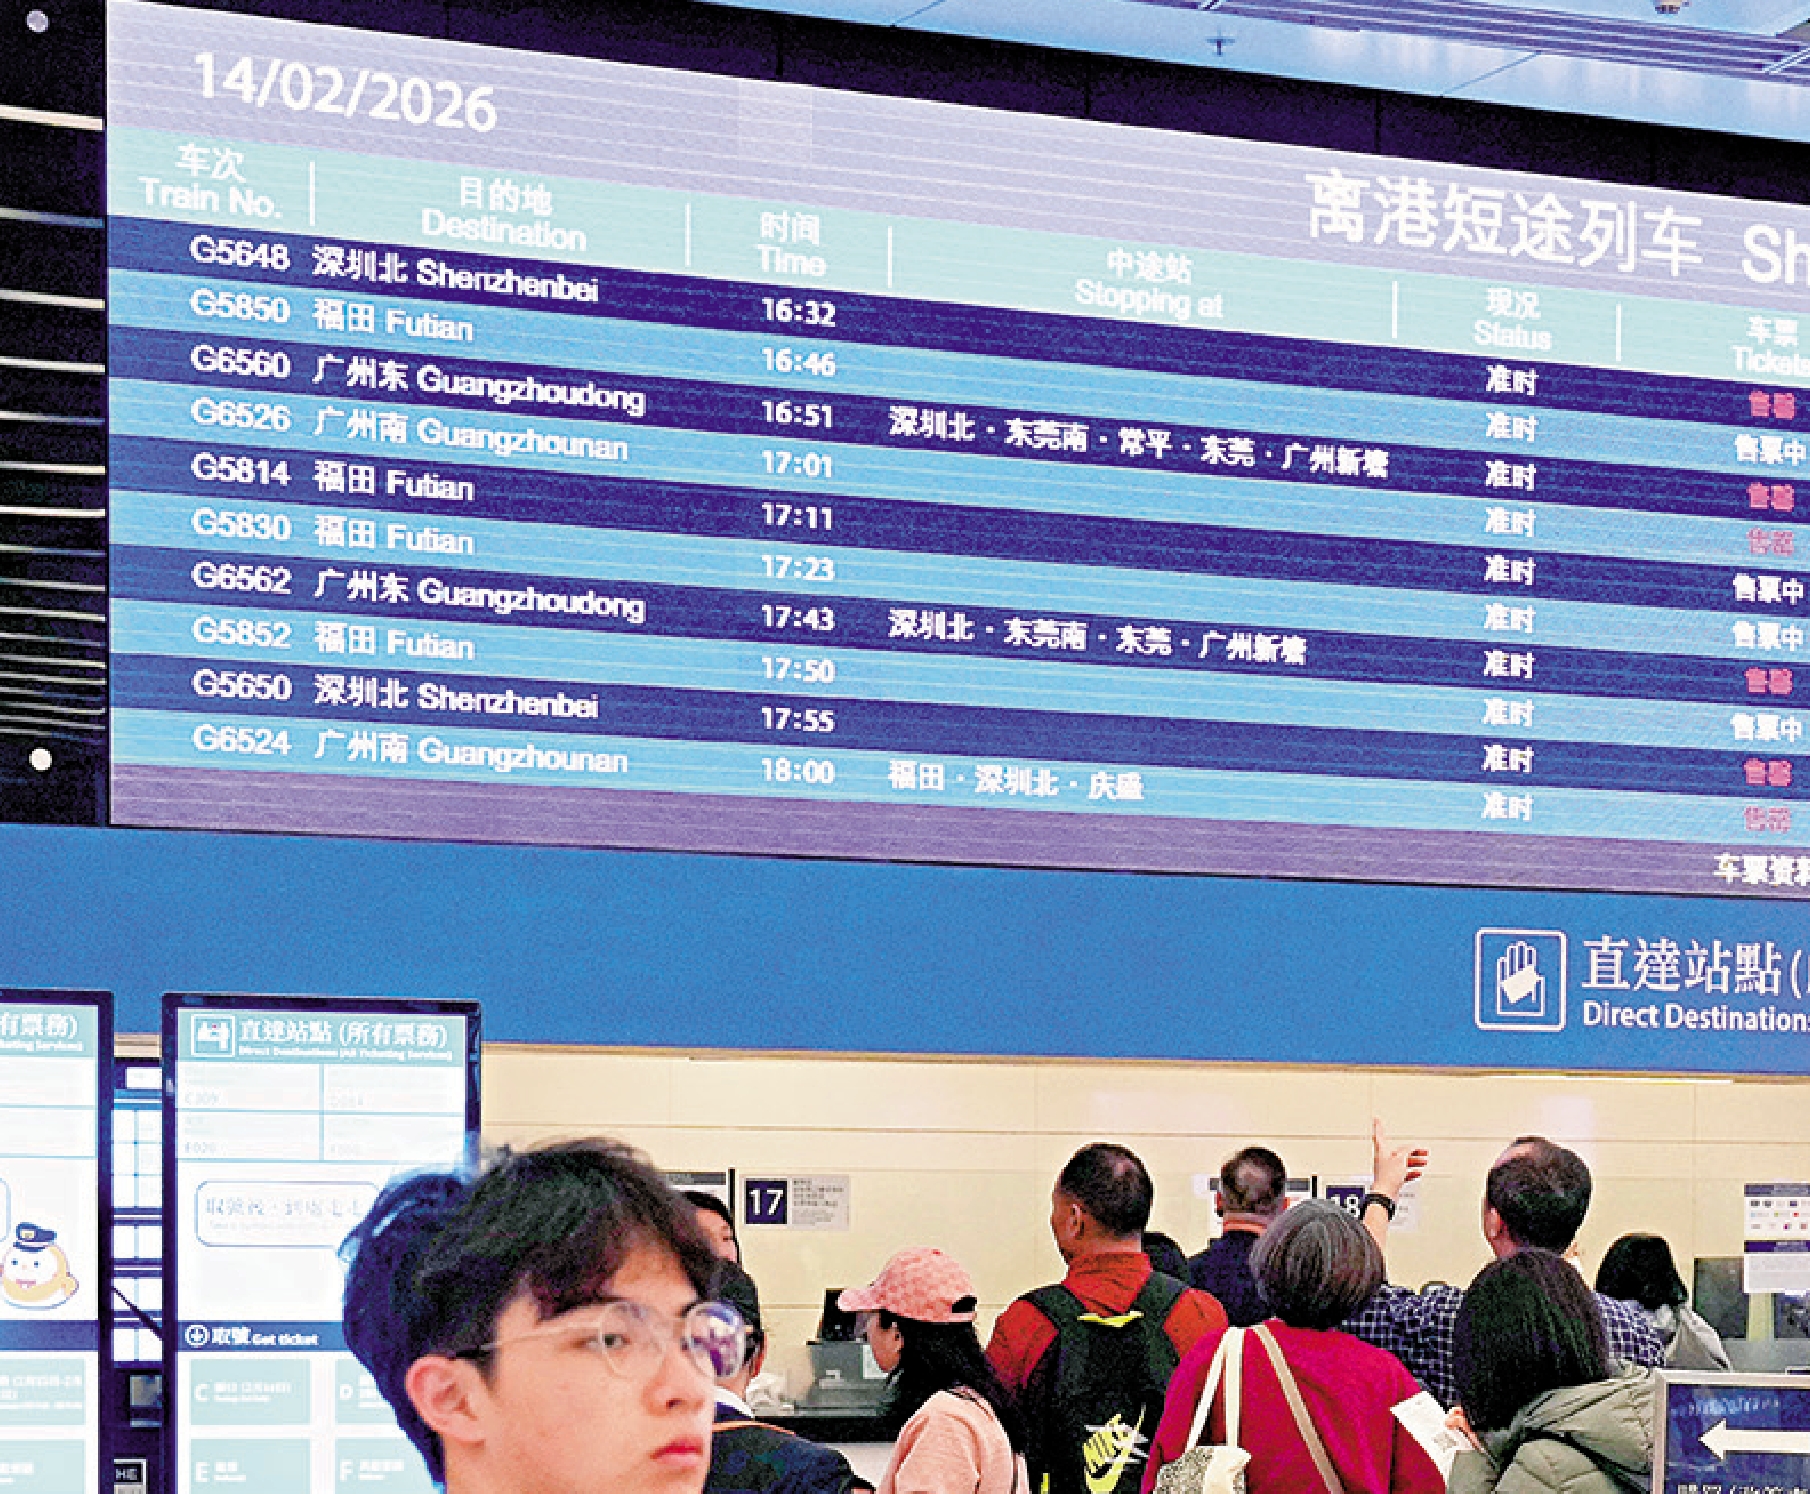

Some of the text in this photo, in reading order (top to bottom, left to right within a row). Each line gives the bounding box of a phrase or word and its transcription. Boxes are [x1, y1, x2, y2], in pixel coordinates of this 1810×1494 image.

[196, 52, 502, 132] 14/02/2026
[175, 143, 246, 183] 车次
[139, 177, 281, 218] Train No.
[461, 176, 552, 216] 目的地
[422, 208, 586, 251] Destination
[760, 211, 819, 247] 时间
[1306, 163, 1708, 276] 离港短途列车
[190, 235, 290, 269] G5648
[312, 244, 408, 283] 深圳北
[416, 258, 601, 304] Shenzhenbei
[762, 299, 835, 327] 16:32
[755, 244, 827, 276] Time
[1107, 247, 1191, 285] 中途站
[1069, 279, 1191, 324] Stopping
[1486, 288, 1541, 320] 现况
[189, 288, 290, 322] G5850
[312, 298, 374, 333] 福田
[386, 308, 472, 341] Futian
[763, 348, 835, 376] 16:46
[1747, 315, 1798, 347] 车票
[191, 345, 290, 377] G6560
[312, 354, 408, 391] 广州东
[418, 364, 647, 417] Guangzhoudong
[762, 402, 831, 427] 16:51
[191, 397, 291, 432] G6526
[314, 406, 408, 443] 广州南
[418, 418, 629, 462] Guangzhounan
[762, 450, 831, 477] 17:01
[191, 452, 290, 484] G5814
[313, 461, 374, 493] 福田
[388, 470, 472, 500] Futian
[762, 502, 831, 530] 17:11
[191, 507, 292, 541] G5830
[315, 514, 375, 548] 福田
[388, 524, 473, 555] Futian
[762, 555, 835, 581] 17:23
[191, 562, 292, 594] G6562
[315, 569, 408, 603] 广州东
[417, 576, 643, 623] Guangzhoudong
[762, 605, 835, 630] 17:43
[192, 615, 292, 649] G5852
[315, 621, 376, 655] 福田
[388, 629, 475, 660] Futian
[762, 656, 835, 683] 17:50
[193, 669, 292, 699] G5650
[315, 674, 408, 708] 深圳北
[417, 683, 598, 719] Shenzhenbei
[762, 708, 833, 731] 17:55
[193, 724, 292, 755] G6524
[315, 729, 408, 763] 广州南
[417, 737, 627, 772] Guangzhounan
[762, 758, 835, 783] 18:00
[1583, 1001, 1659, 1029] Direct
[749, 1187, 783, 1216] 17
[194, 1383, 210, 1402] C
[195, 1461, 210, 1482] E
